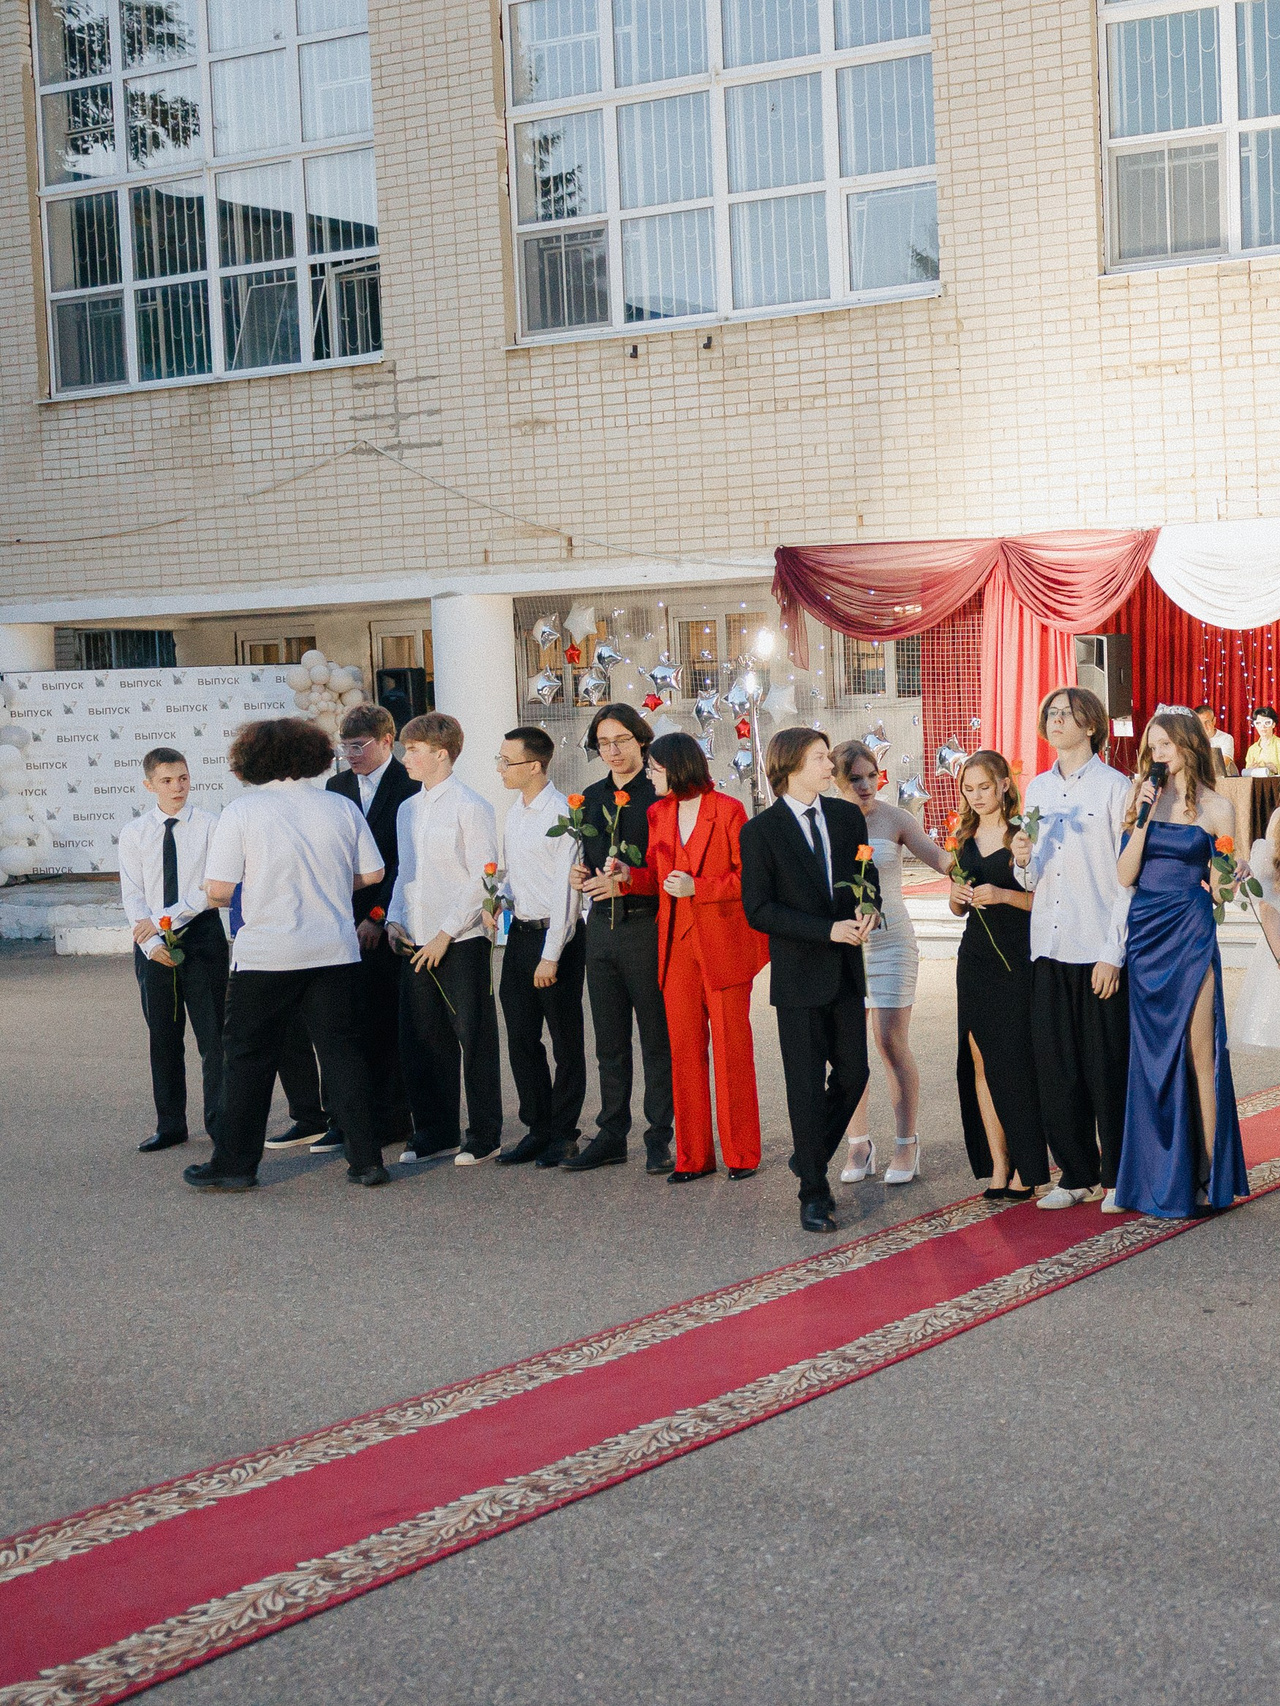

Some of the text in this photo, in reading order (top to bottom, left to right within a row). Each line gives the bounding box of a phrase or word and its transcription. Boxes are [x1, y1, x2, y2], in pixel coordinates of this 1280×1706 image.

[42, 681, 84, 691] ВЫПУСК
[120, 679, 162, 689] ВЫПУСК
[198, 677, 240, 686] ВЫПУСК
[88, 706, 130, 716] ВЫПУСК
[166, 704, 208, 713] ВЫПУСК
[244, 701, 286, 711] ВЫПУСК
[10, 709, 52, 718] ВЫПУСК
[57, 734, 99, 743] ВЫПУСК
[134, 731, 176, 741] ВЫПУСК
[26, 761, 68, 771] ВЫПУСК
[114, 759, 143, 768] ВЫПУ
[94, 785, 136, 795] ВЫПУСК
[190, 782, 224, 792] ЫПУСК
[73, 812, 115, 822] ВЫПУСК
[52, 840, 94, 849] ВЫПУСК
